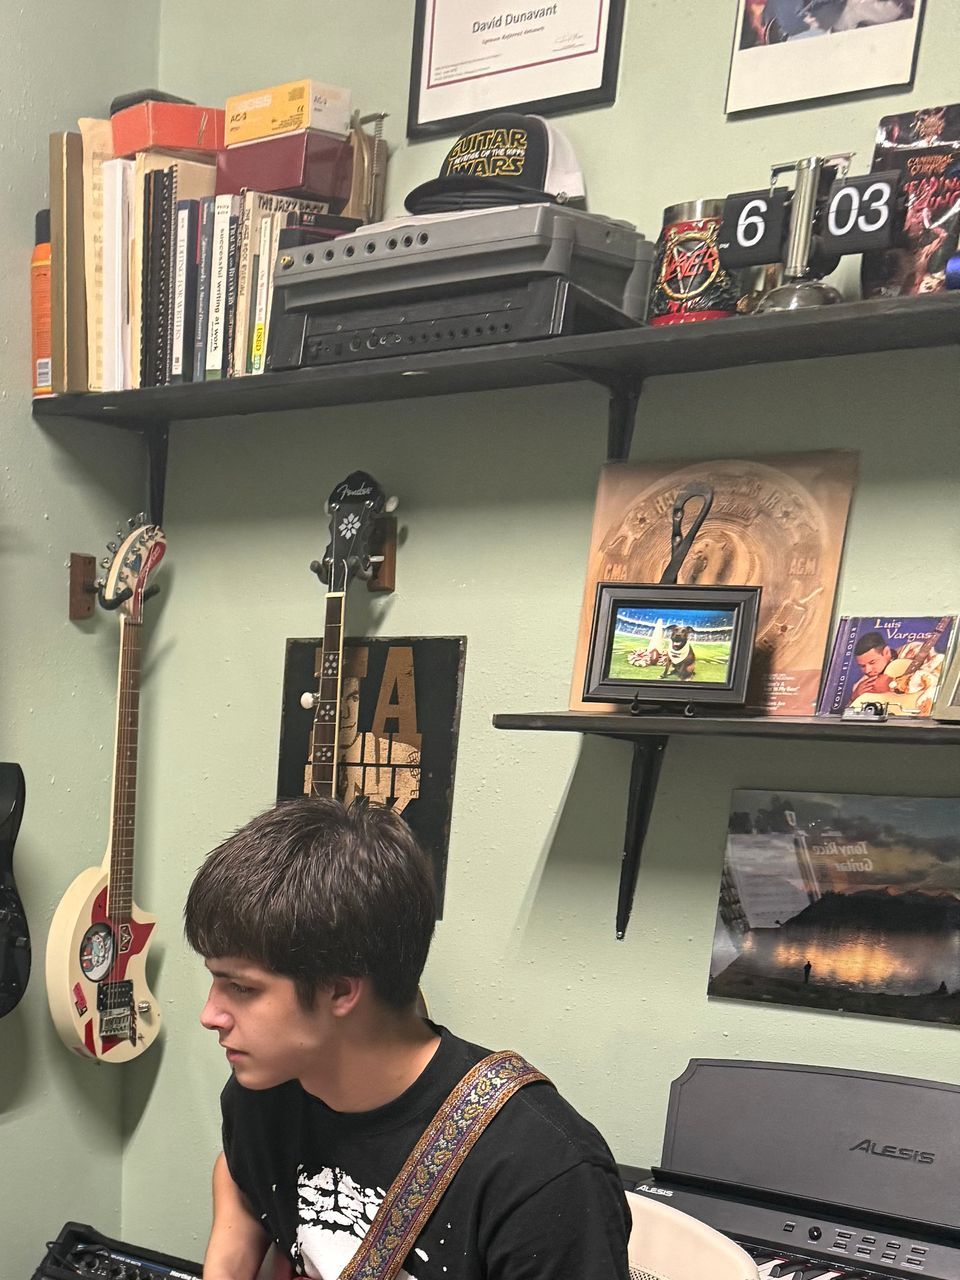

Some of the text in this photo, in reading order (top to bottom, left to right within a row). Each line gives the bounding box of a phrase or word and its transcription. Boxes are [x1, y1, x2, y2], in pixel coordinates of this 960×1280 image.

[472, 4, 558, 34] David Dunavant
[736, 199, 768, 247] 6
[827, 182, 891, 237] 03
[217, 228, 225, 278] successful
[214, 281, 223, 313] writing
[255, 327, 263, 352] USED
[337, 482, 373, 500] Fender
[874, 618, 902, 629] Luis
[886, 628, 932, 643] Vargas
[849, 1139, 936, 1165] ALESIS
[637, 1184, 673, 1197] ALESIS
